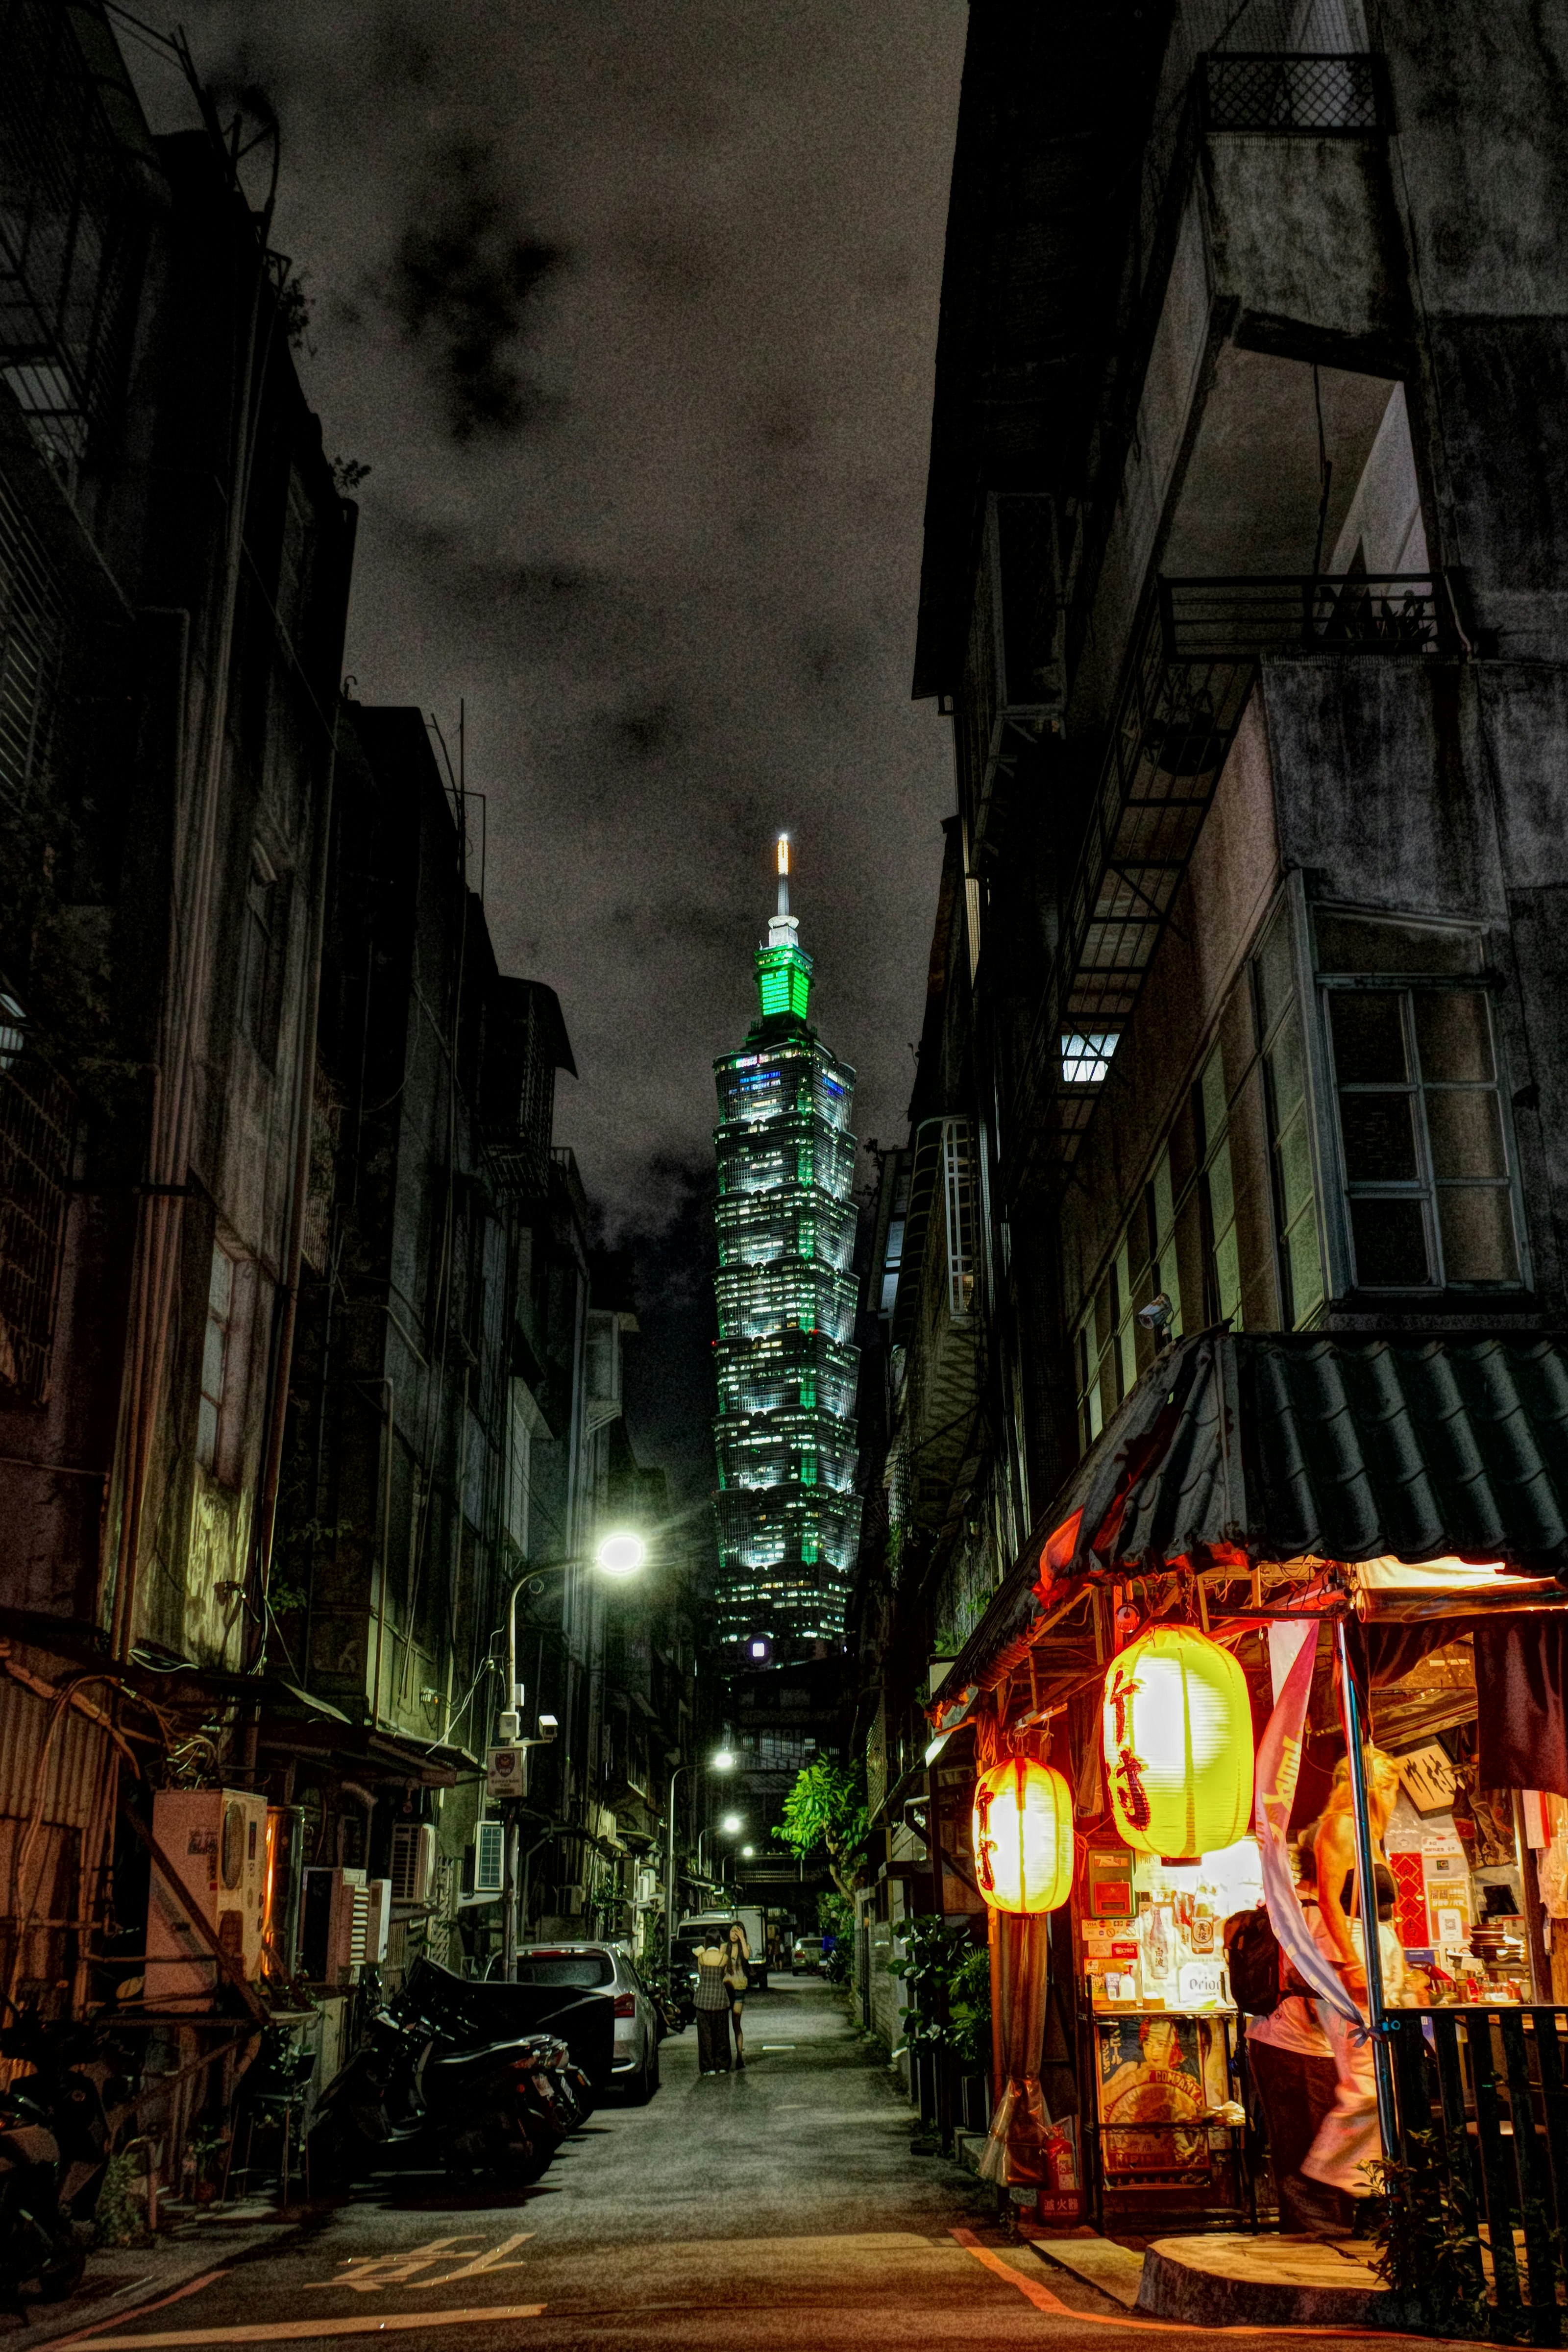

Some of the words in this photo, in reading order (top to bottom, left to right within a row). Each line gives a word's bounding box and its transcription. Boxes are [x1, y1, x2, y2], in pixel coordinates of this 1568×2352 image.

[1155, 1947, 1165, 1968] 白波
[1044, 2198, 1078, 2210] 滅火器
